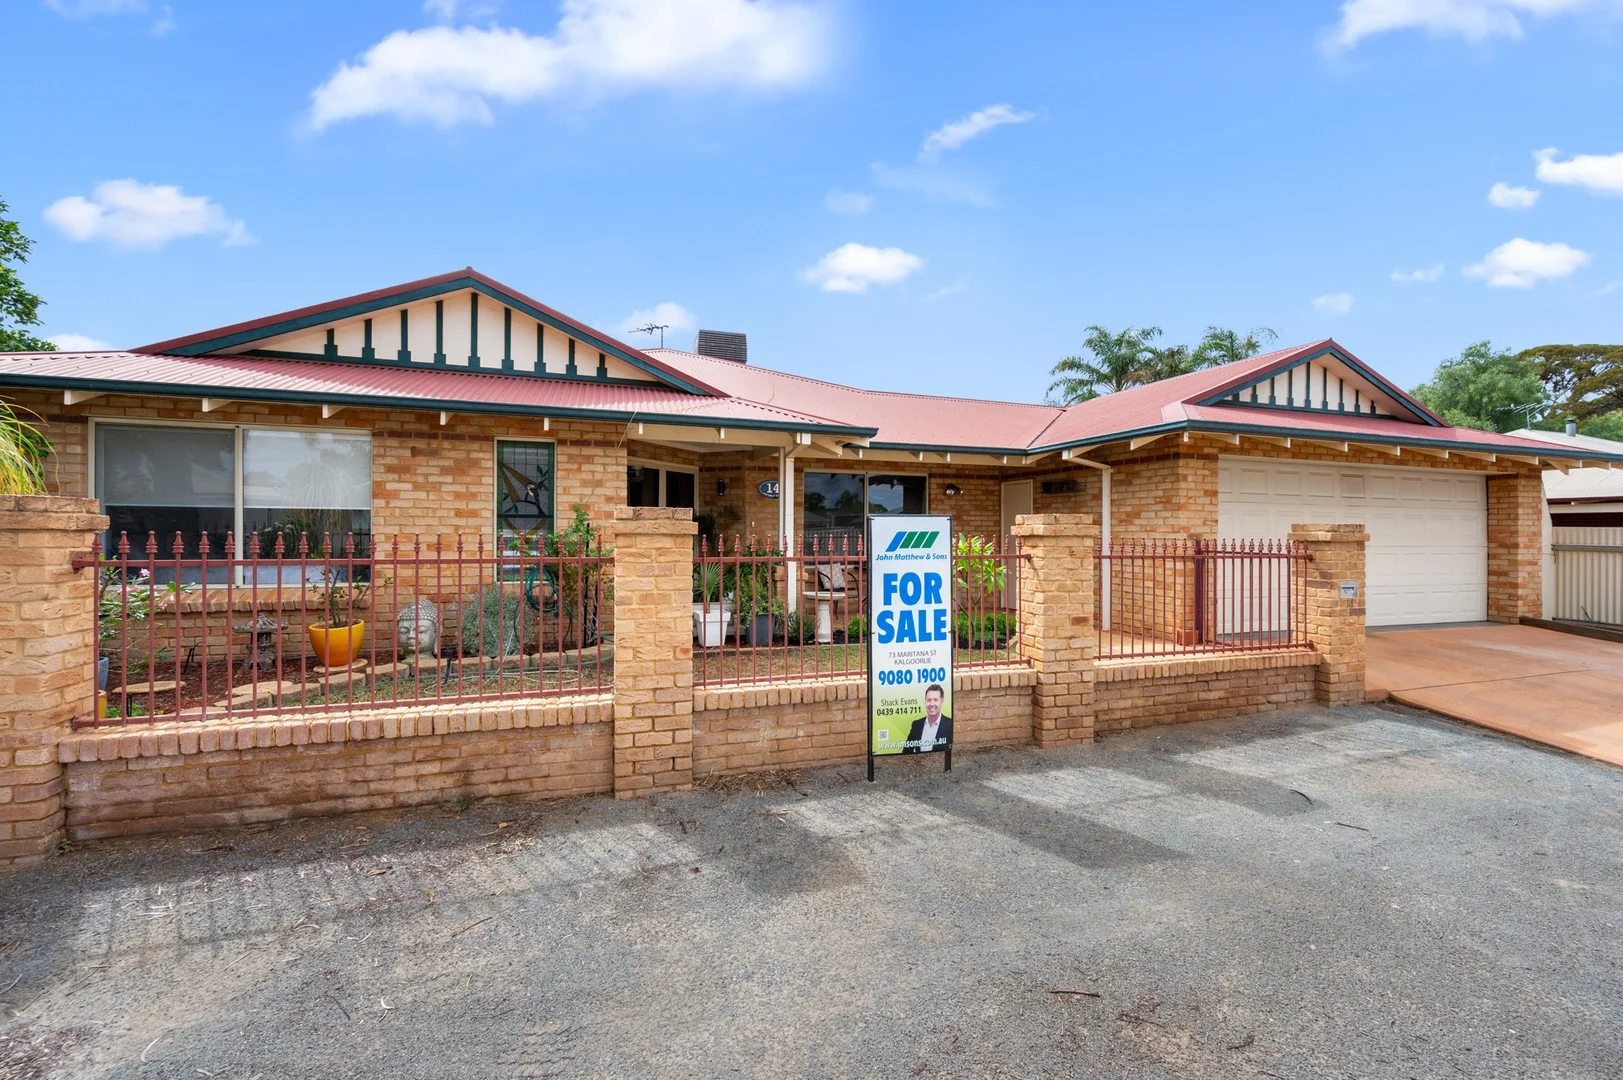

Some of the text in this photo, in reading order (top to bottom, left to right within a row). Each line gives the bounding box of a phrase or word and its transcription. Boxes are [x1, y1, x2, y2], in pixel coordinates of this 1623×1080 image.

[766, 483, 779, 494] 14
[894, 553, 924, 561] Matthew
[883, 572, 943, 606] FOR
[876, 609, 947, 644] SALE
[897, 650, 929, 658] MARITANA
[878, 667, 946, 686] 9080 1900
[881, 698, 918, 707] Shack Evans
[876, 708, 894, 716] 0439
[909, 706, 922, 714] 711
